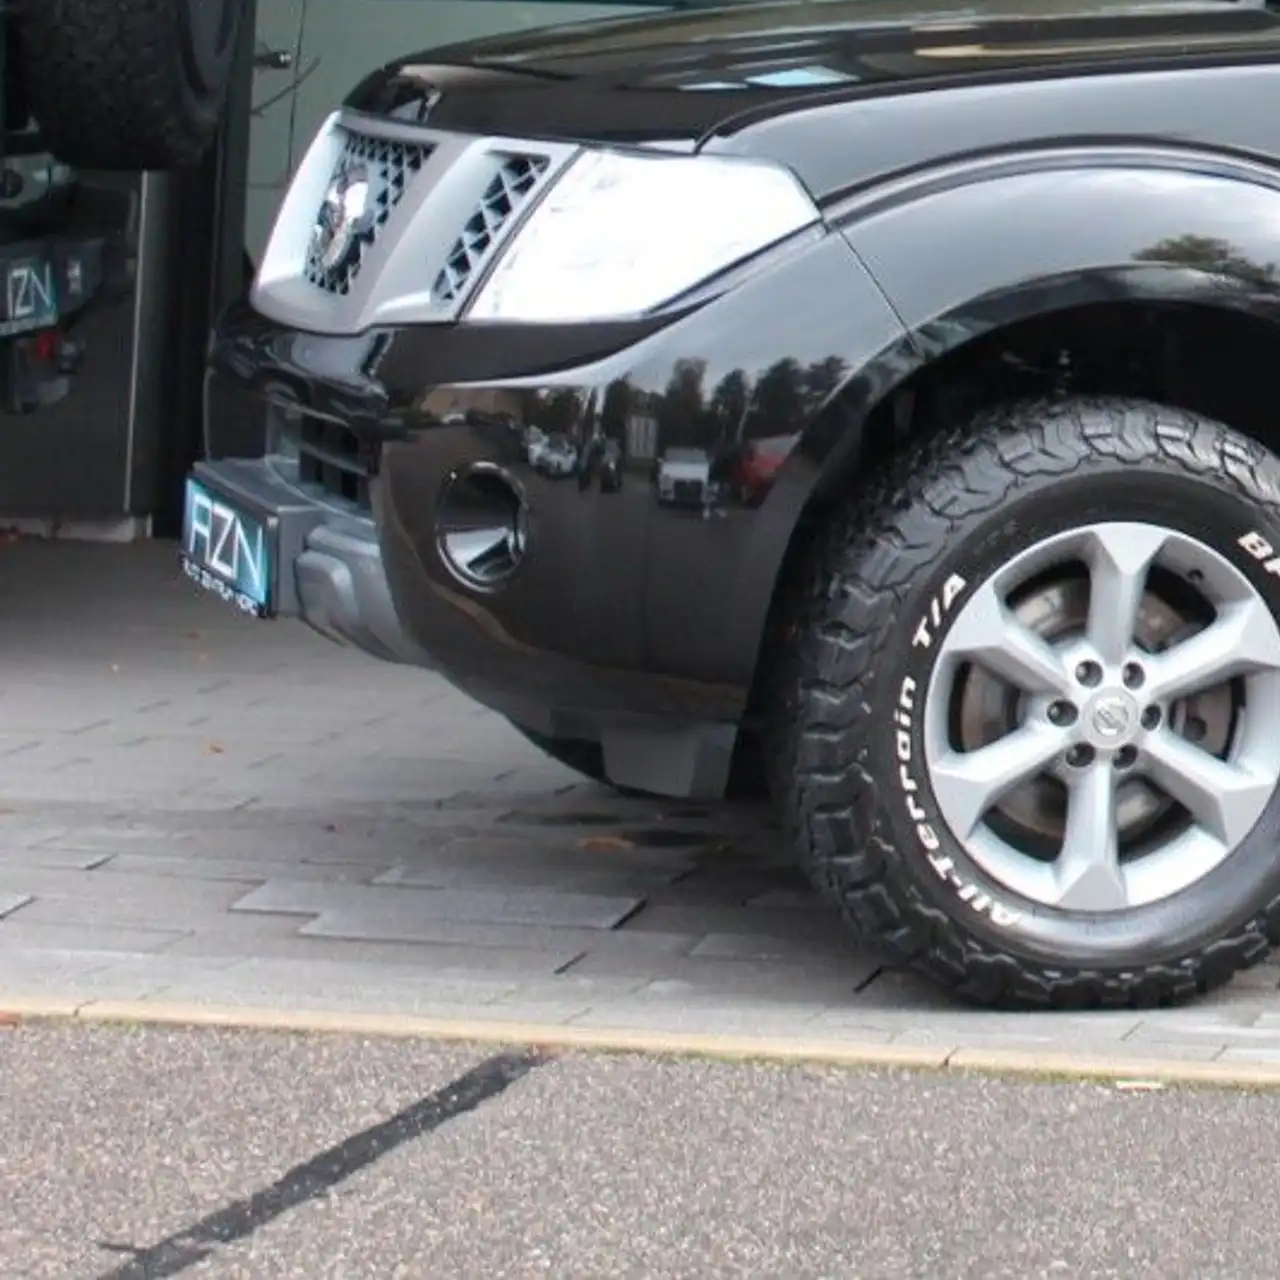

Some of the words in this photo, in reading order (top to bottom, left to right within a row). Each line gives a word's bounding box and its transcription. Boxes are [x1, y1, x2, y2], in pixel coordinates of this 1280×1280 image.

[7, 261, 52, 320] ZN
[190, 493, 266, 602] AZN
[912, 573, 968, 648] T/A
[892, 676, 1023, 927] All-Terrain
